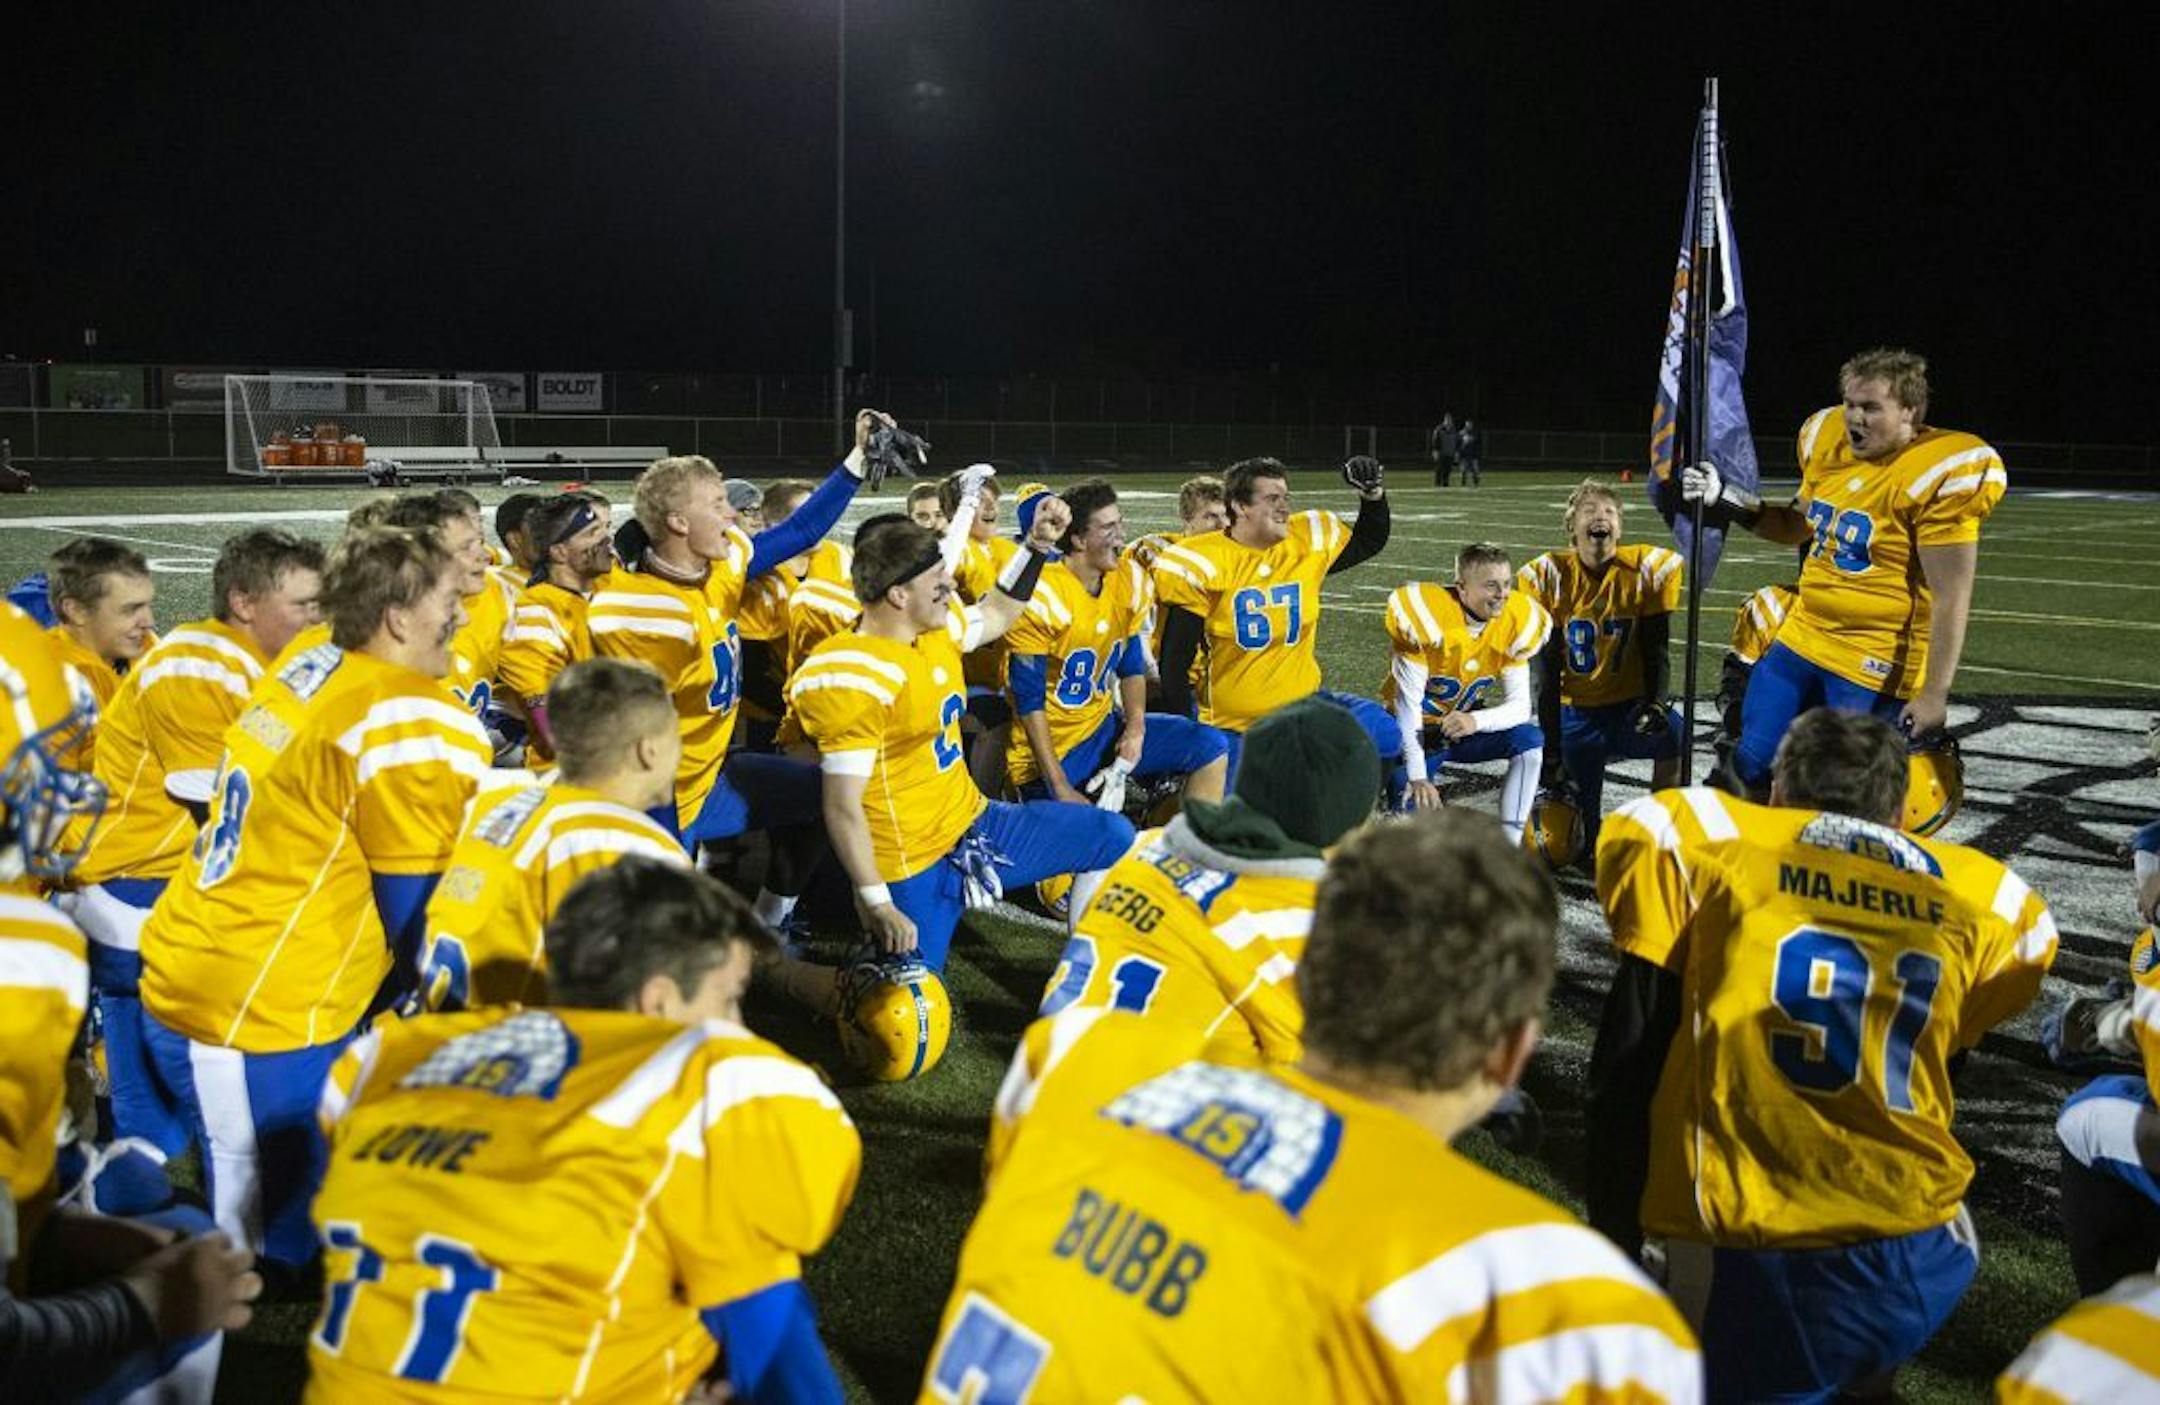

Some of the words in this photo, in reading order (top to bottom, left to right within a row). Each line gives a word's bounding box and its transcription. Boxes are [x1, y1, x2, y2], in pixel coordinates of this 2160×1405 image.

[543, 379, 597, 396] BOLDT
[1233, 580, 1302, 652] 67
[706, 619, 743, 717] 4
[1770, 922, 1944, 1116] 91
[352, 1124, 493, 1173] LOWE
[1052, 1186, 1209, 1319] BUBB
